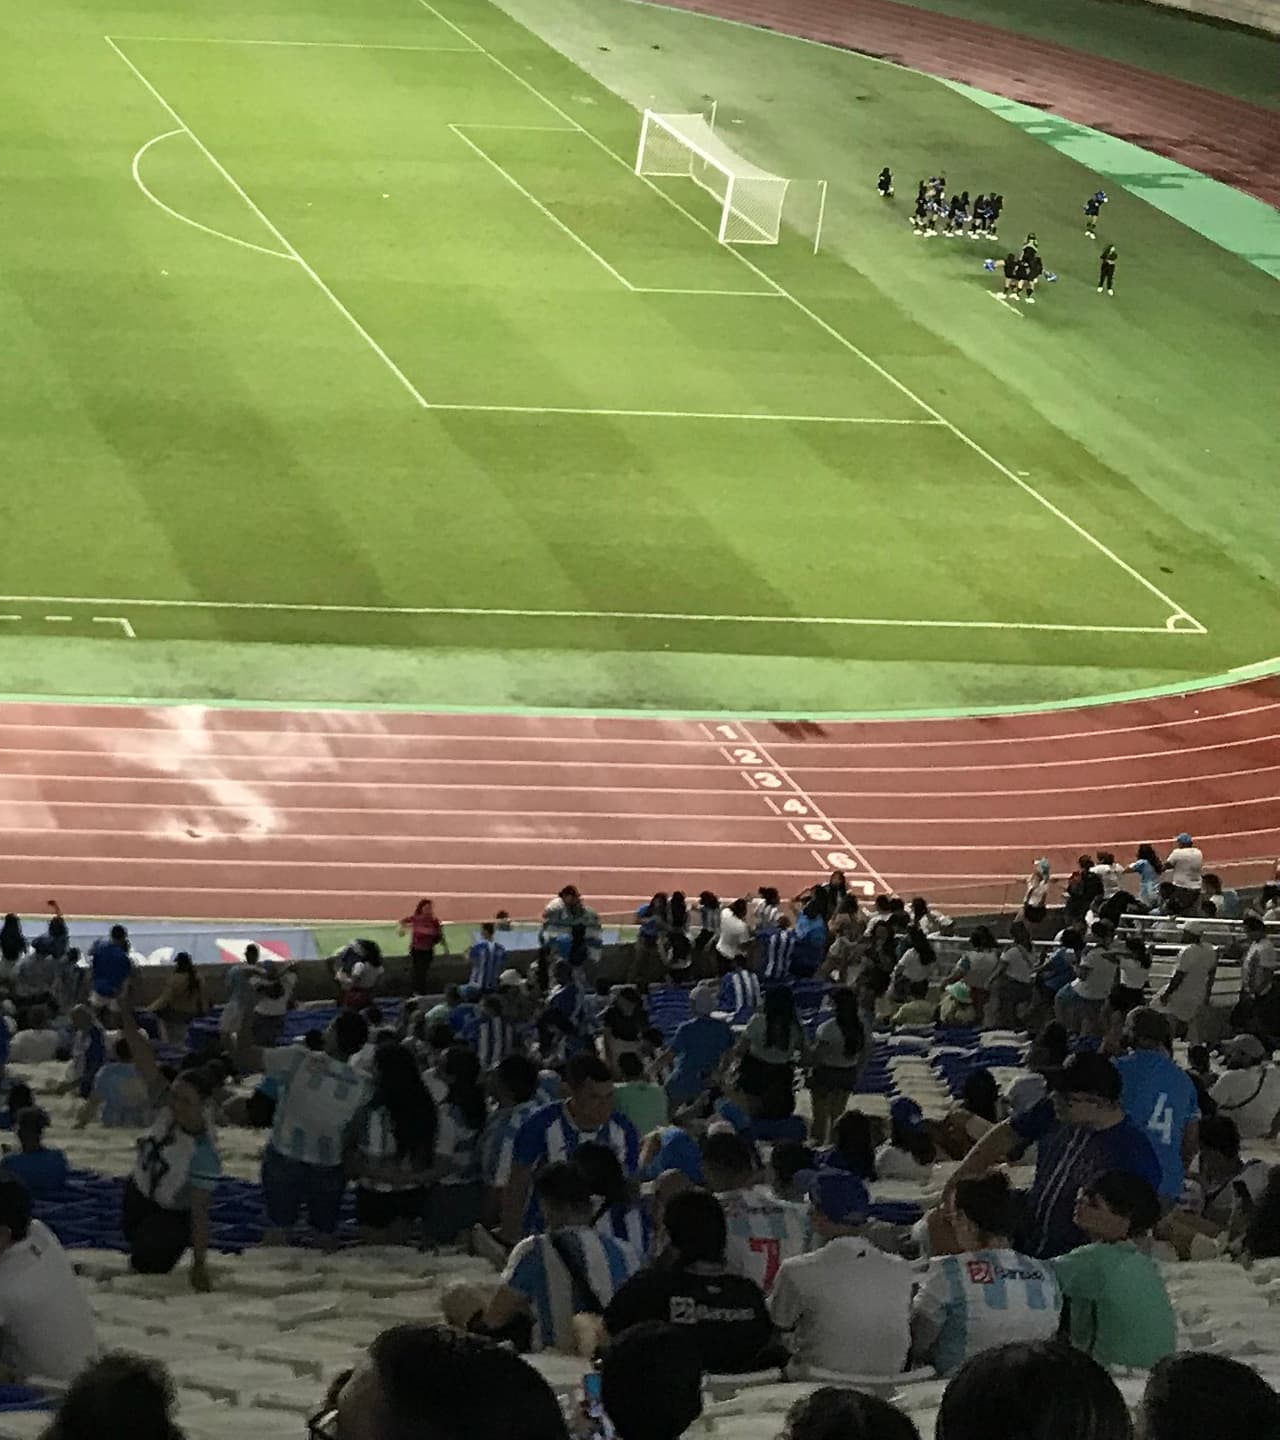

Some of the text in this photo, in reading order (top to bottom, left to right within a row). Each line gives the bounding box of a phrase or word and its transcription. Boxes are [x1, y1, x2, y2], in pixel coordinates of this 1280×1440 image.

[717, 725, 738, 740] 1
[734, 749, 763, 764] 2
[754, 772, 782, 788] 3
[783, 799, 808, 815] 4
[803, 824, 833, 841] 5
[827, 852, 857, 870] 6
[1146, 1091, 1173, 1145] 4
[749, 1237, 781, 1292] 7
